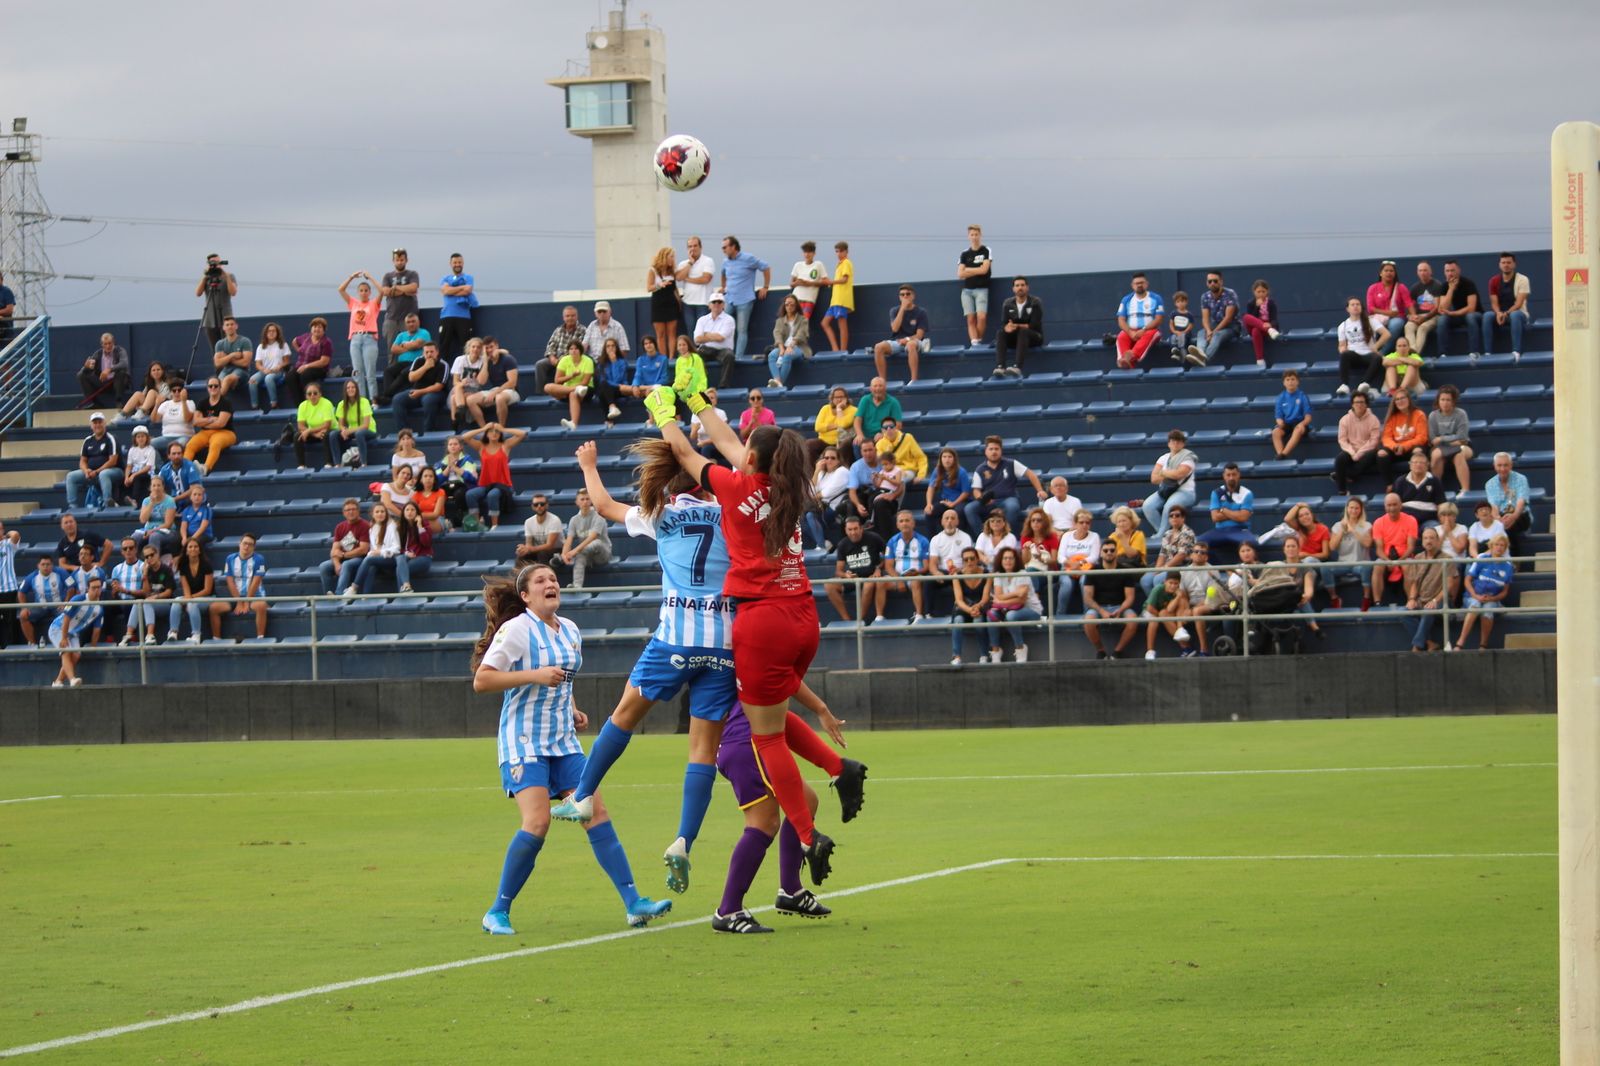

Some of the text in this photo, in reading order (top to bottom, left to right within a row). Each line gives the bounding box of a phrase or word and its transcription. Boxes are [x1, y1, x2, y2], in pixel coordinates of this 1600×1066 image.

[1568, 172, 1576, 204] SPORT
[1568, 222, 1577, 256] URBAN
[703, 509, 722, 527] RU
[681, 525, 714, 586] 7
[689, 656, 736, 669] COSTA DEL
